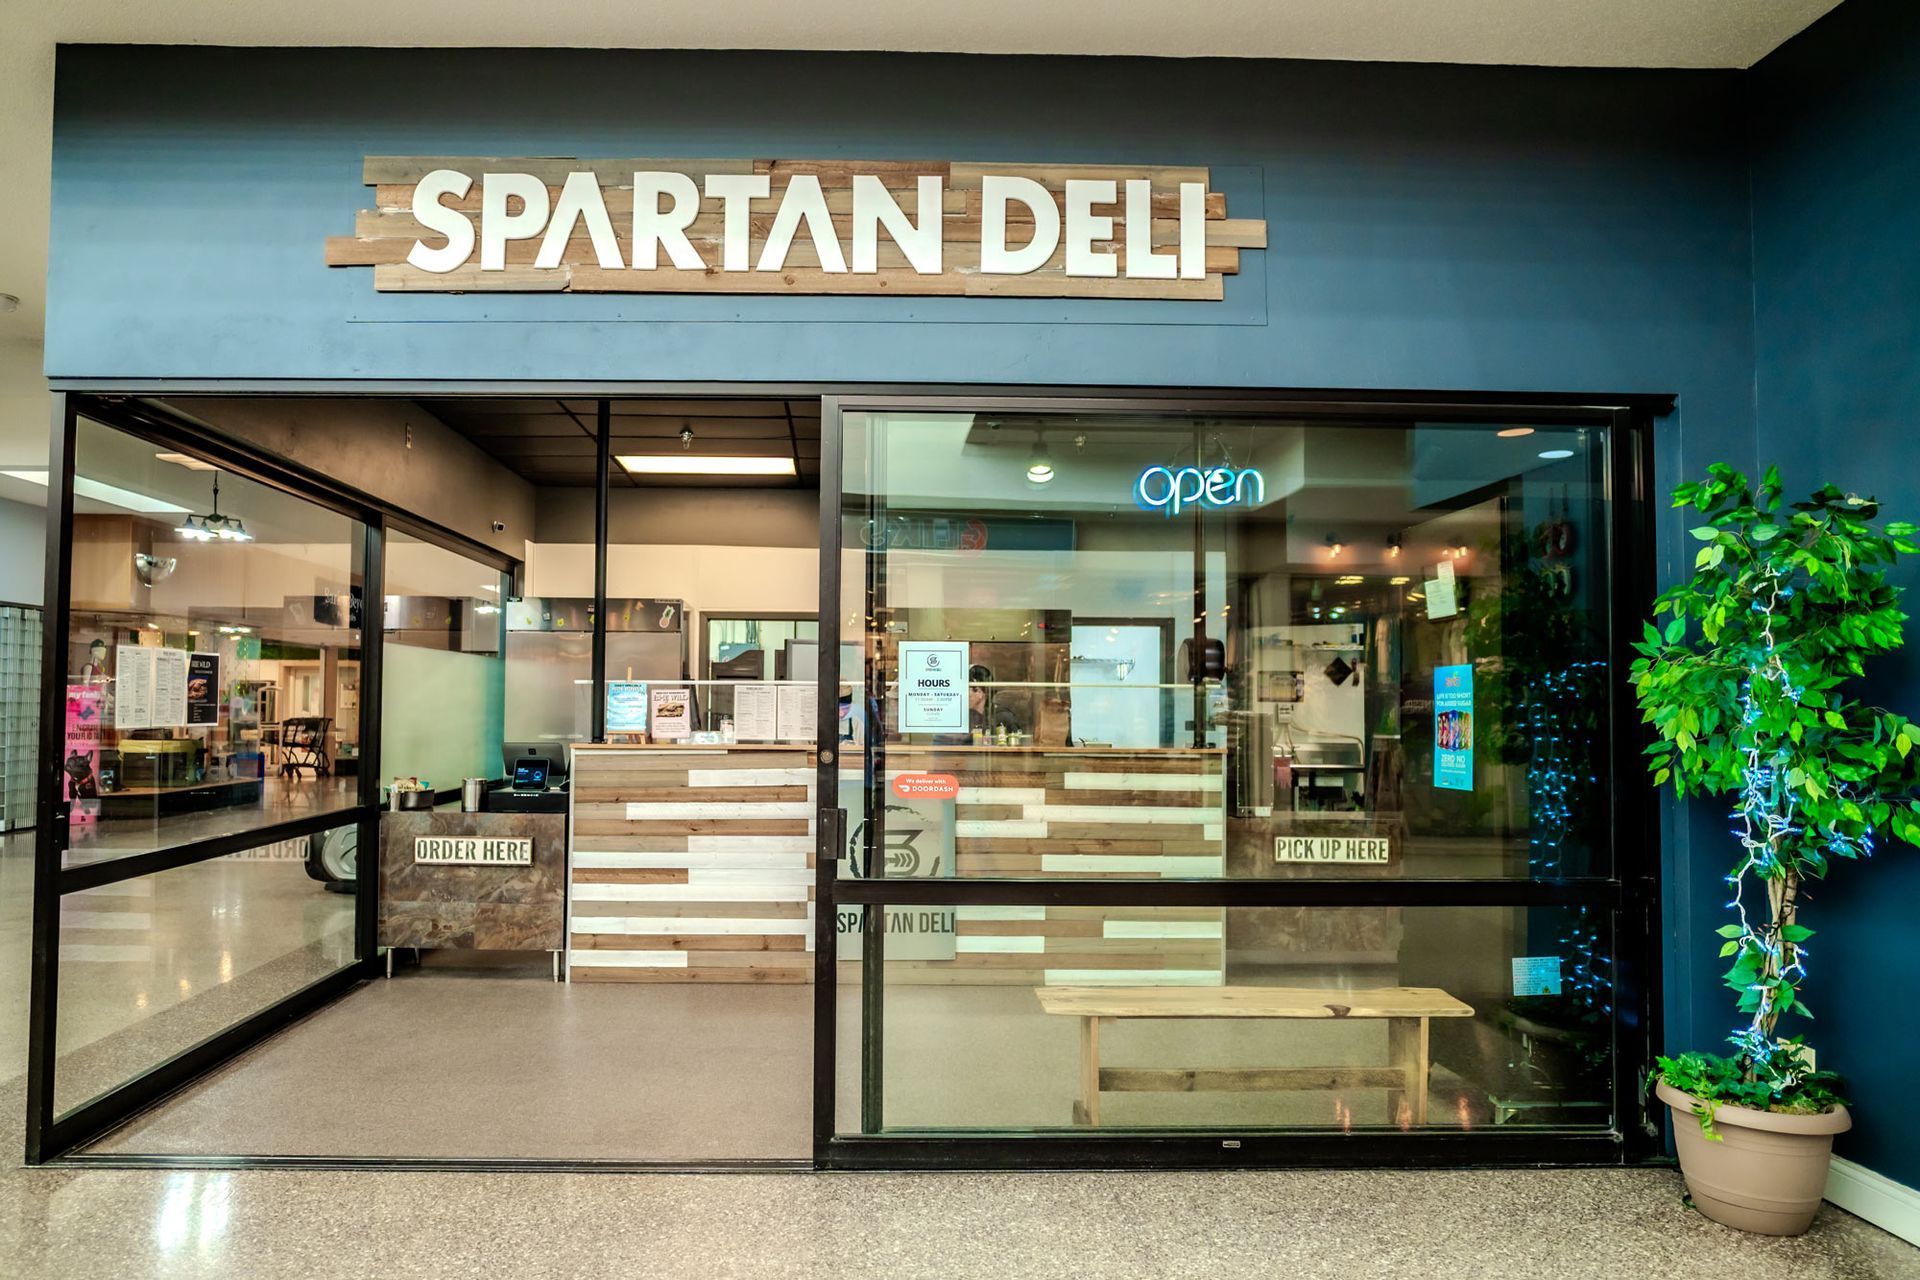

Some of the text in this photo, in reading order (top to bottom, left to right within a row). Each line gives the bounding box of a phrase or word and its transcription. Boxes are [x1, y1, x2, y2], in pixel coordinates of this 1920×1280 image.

[406, 168, 1206, 280] SPARTAN DELI
[917, 679, 951, 688] HOURS
[416, 839, 530, 861] ORDER HERE
[1276, 839, 1388, 861] PICK UP HERE
[919, 912, 955, 934] DELI
